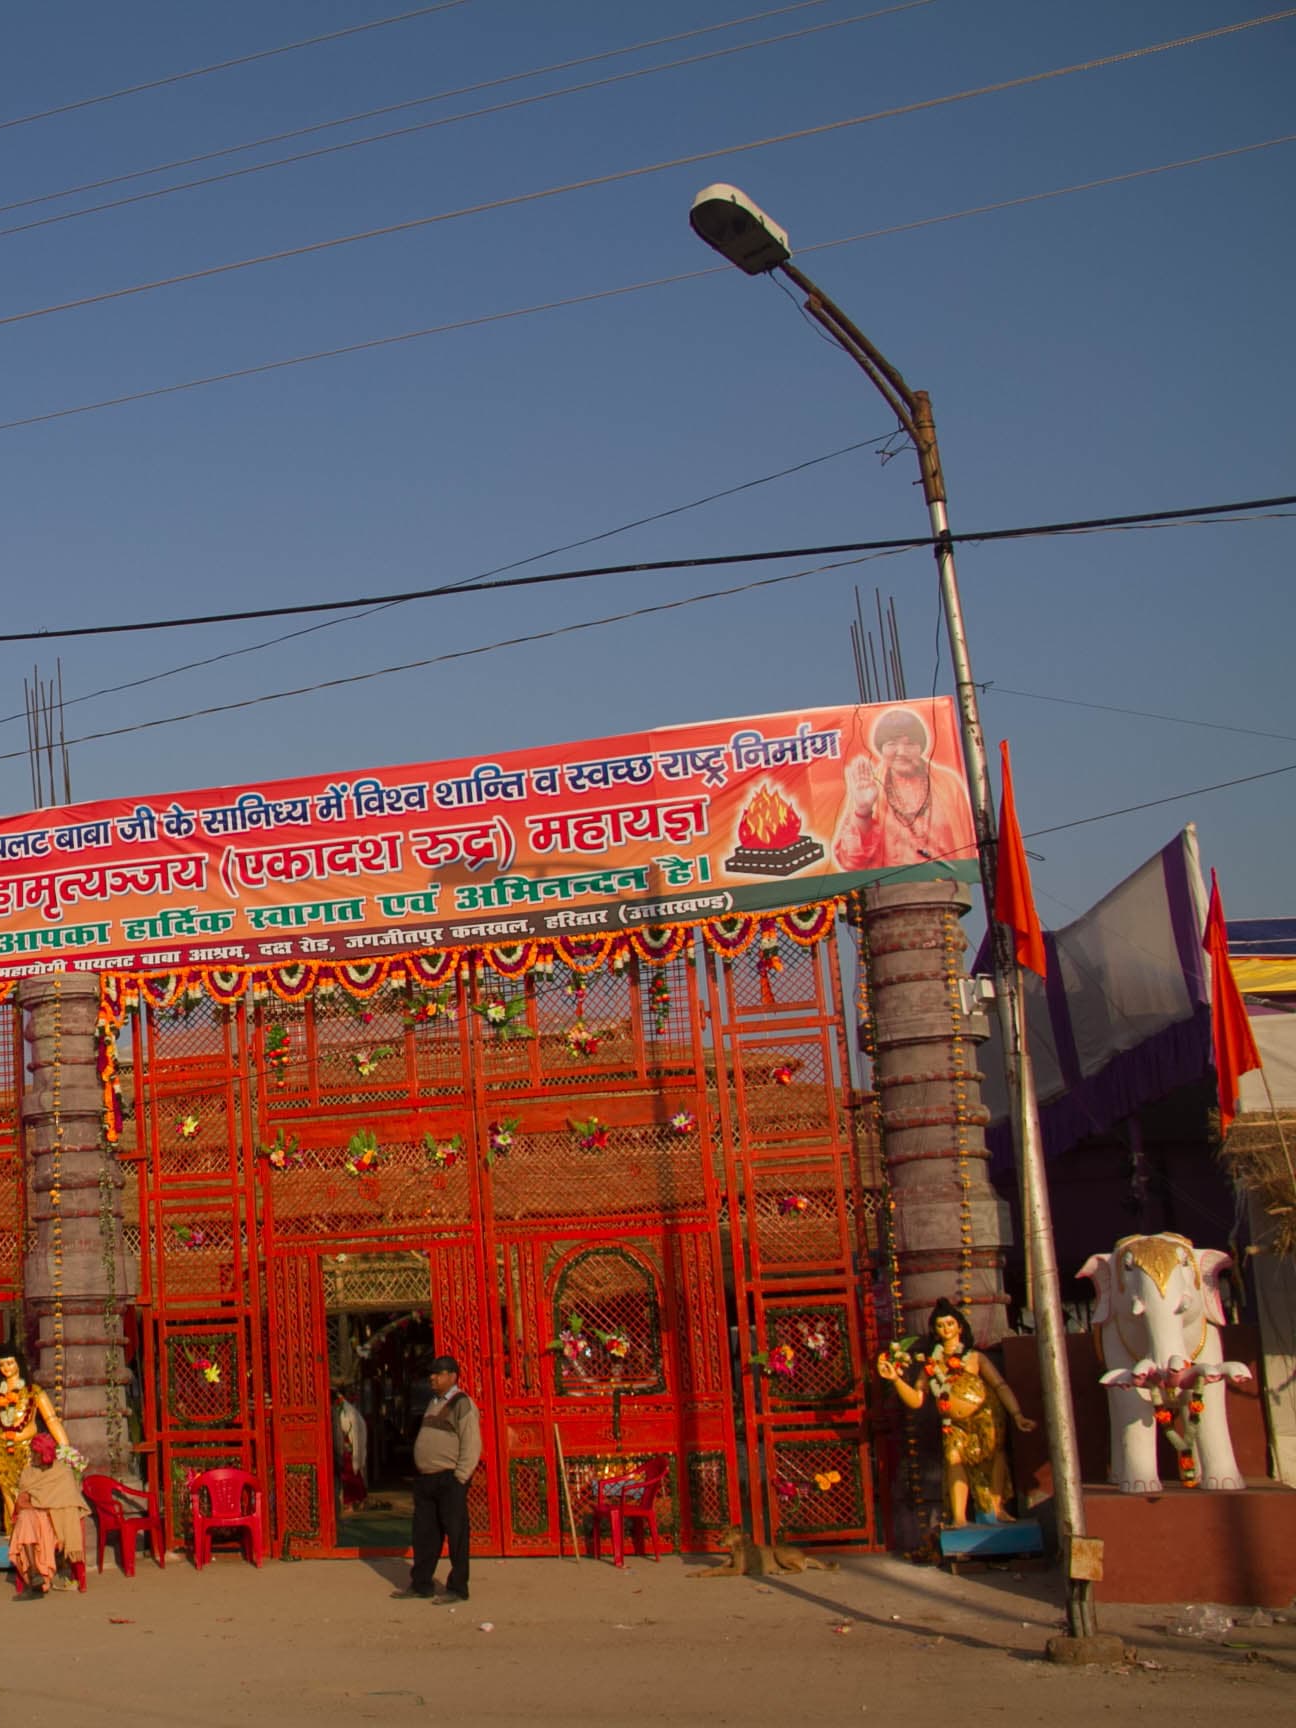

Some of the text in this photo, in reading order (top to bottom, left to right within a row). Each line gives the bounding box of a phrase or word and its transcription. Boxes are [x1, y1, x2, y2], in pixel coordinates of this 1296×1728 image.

[55, 819, 112, 851] बाबा
[115, 805, 158, 841] जी
[162, 802, 196, 837] के
[202, 793, 310, 836] सानिध्य
[316, 783, 348, 821] में
[353, 779, 427, 818] विश्व
[435, 764, 525, 807] शान्ति
[532, 766, 559, 795] व
[566, 755, 653, 791] स्वच्छ
[658, 744, 728, 787] राष्ट्र
[731, 722, 841, 772] निर्माण
[221, 831, 402, 897] (एकादश
[410, 816, 515, 871] रुद्र)
[526, 794, 709, 854] महायज्ञ
[73, 955, 135, 971] पायलट
[189, 945, 250, 962] आश्रम,
[258, 941, 293, 956] दक्ष
[299, 936, 336, 954] रोड,
[344, 927, 444, 948] जगजीतपुर
[450, 919, 536, 939] कनखल,
[543, 909, 608, 930] हरिद्वार
[618, 891, 734, 924] (उत्तराखण्ड)
[121, 906, 236, 939] हार्दिक
[245, 897, 366, 929] स्वागत
[376, 883, 441, 919] एवं
[455, 864, 650, 910] अभिनन्दन
